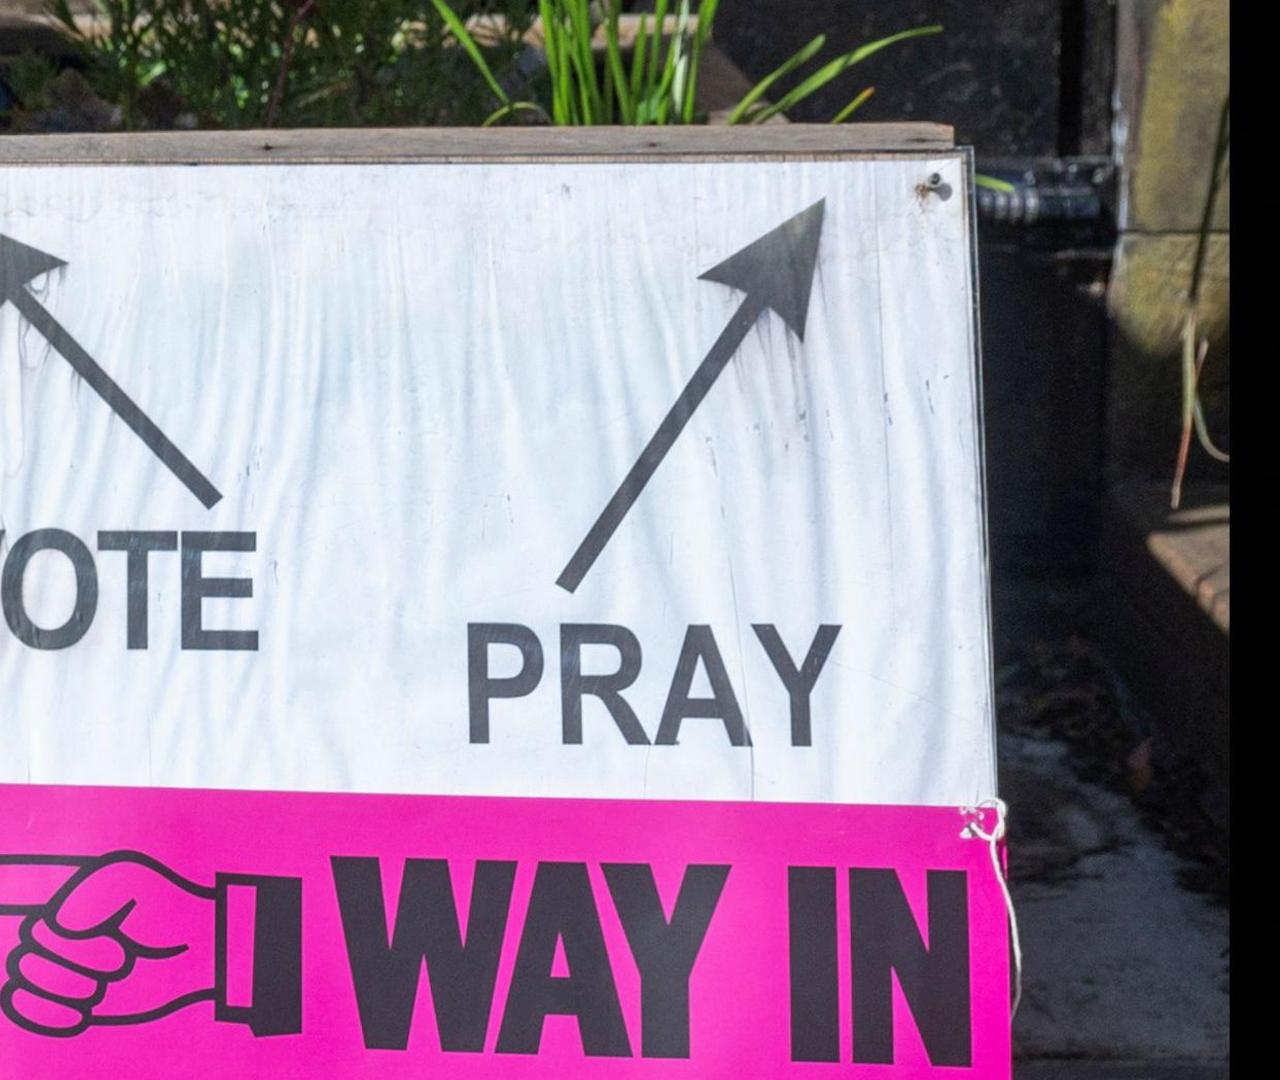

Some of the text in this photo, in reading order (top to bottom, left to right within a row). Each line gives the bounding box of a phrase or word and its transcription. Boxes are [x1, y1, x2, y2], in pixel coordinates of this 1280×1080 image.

[467, 623, 842, 746] PRAY
[330, 855, 972, 1067] WAY IN
